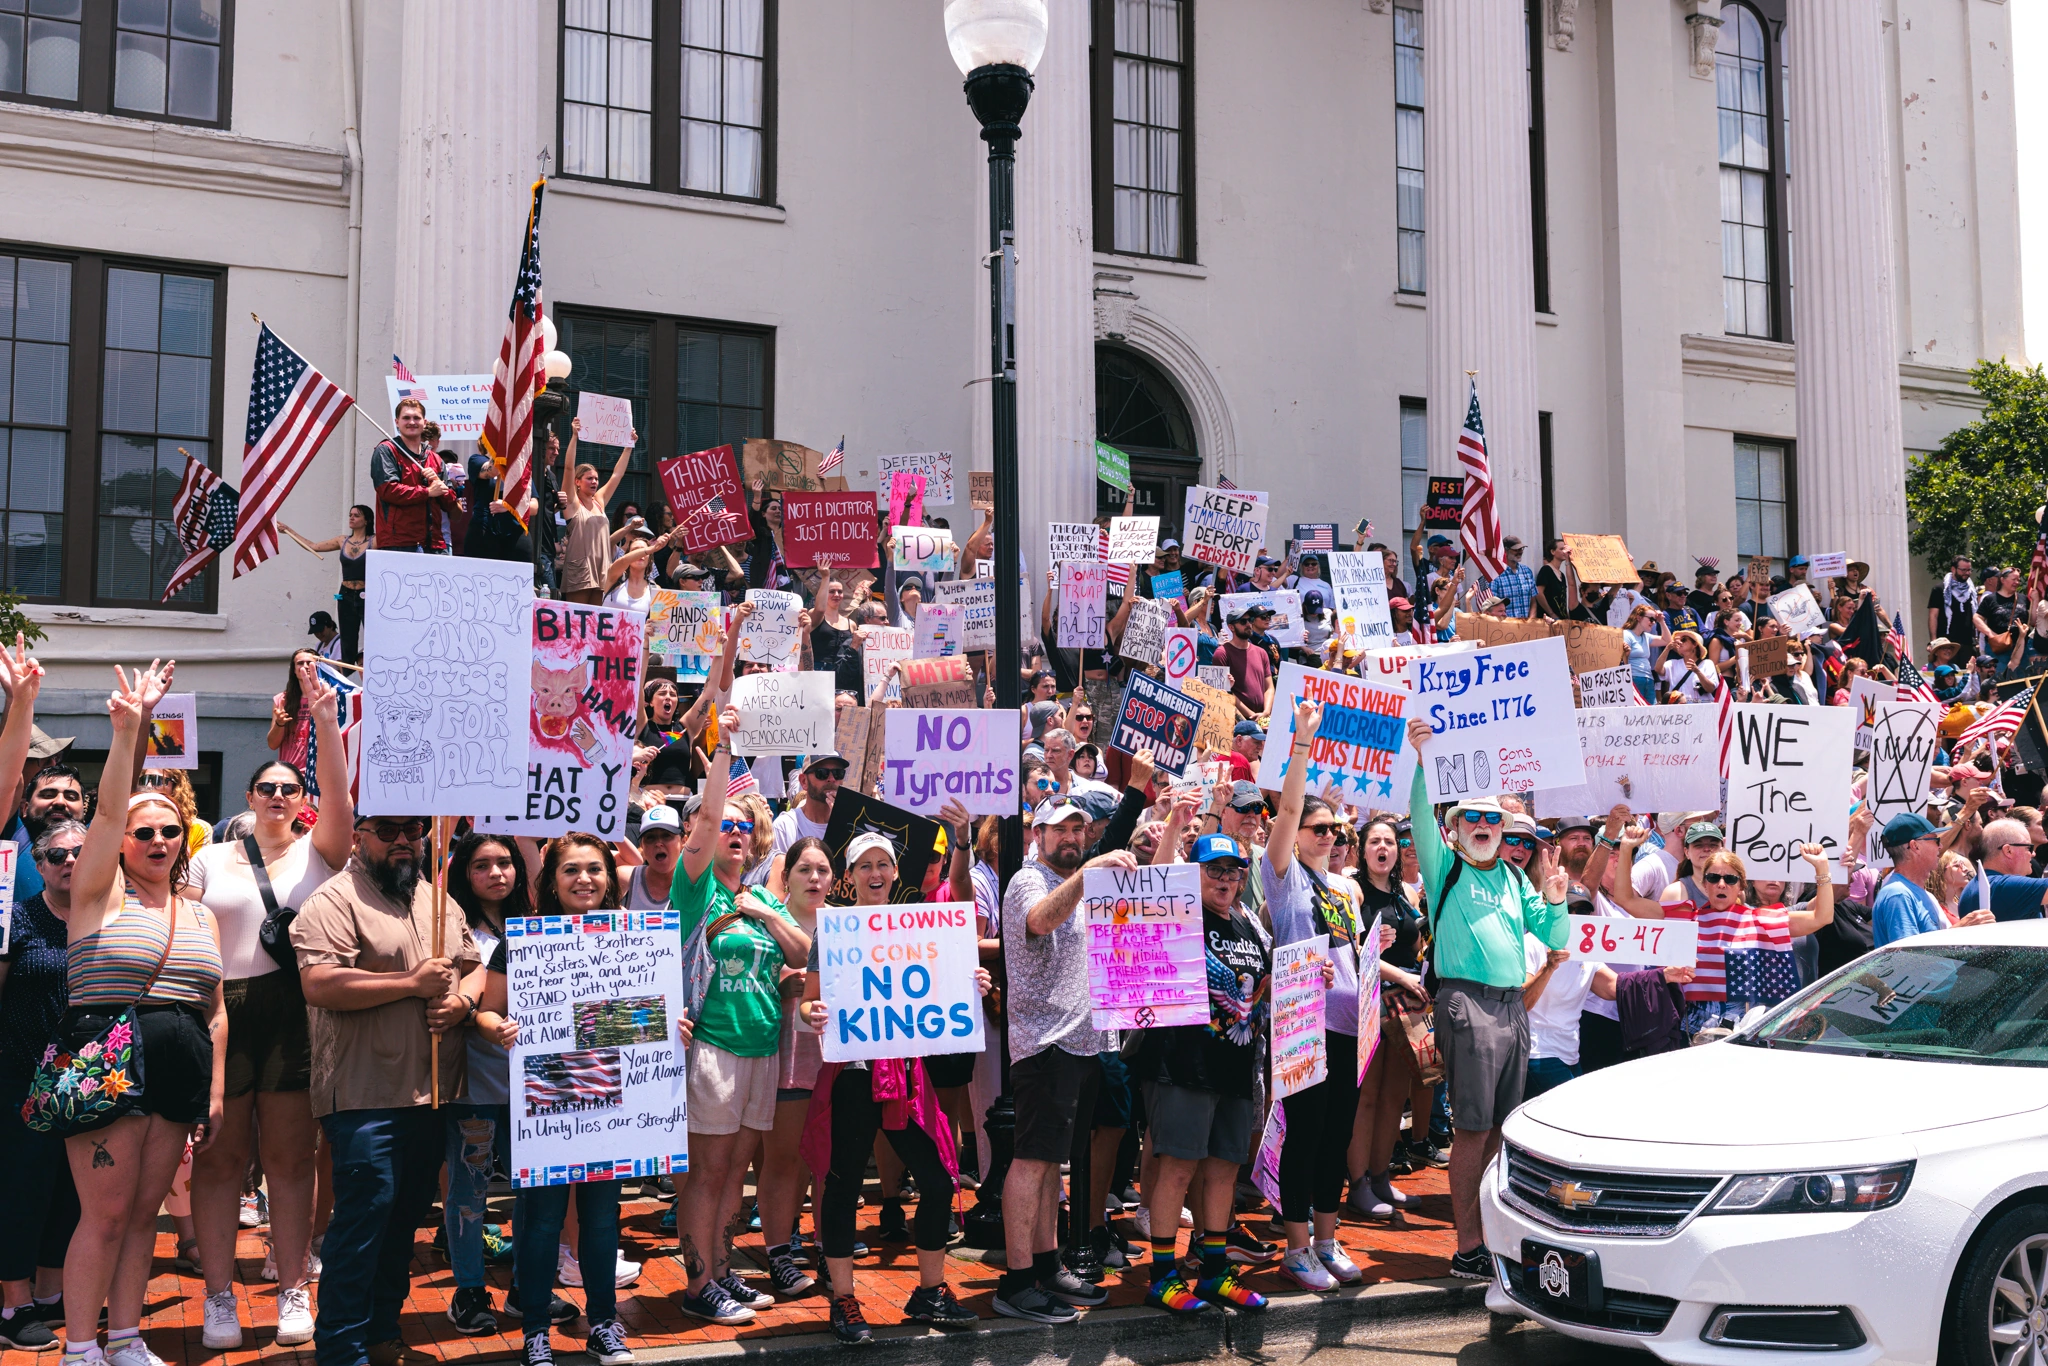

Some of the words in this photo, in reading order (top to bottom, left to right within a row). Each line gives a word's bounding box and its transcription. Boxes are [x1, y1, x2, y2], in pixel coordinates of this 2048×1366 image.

[456, 413, 472, 421] the
[595, 412, 630, 428] WORLD
[881, 455, 936, 470] DEFEND
[788, 503, 812, 520] NOT
[815, 502, 822, 518] A
[1203, 491, 1253, 518] KEEP
[684, 522, 748, 551] LEGAL
[795, 524, 826, 542] JUST
[830, 523, 839, 540] A
[1052, 524, 1071, 534] THE
[1072, 525, 1096, 536] ONLY
[1112, 531, 1157, 541] SILENCE
[1119, 521, 1156, 532] WILL
[902, 533, 950, 561] FDT
[1050, 534, 1094, 544] MINORITY
[1112, 540, 1125, 549] BE
[1195, 525, 1254, 554] DEPORT
[1336, 553, 1365, 568] KNOW
[1068, 565, 1108, 581] DONALD
[1331, 569, 1349, 584] YOUR
[1351, 567, 1386, 584] PARASITES
[753, 590, 794, 602] DONALD
[1360, 586, 1373, 594] TICK
[379, 570, 534, 636] LIBERTY
[754, 600, 791, 612] TRUMP
[1069, 601, 1080, 614] IS
[1086, 601, 1096, 614] A
[1364, 598, 1379, 607] TICK
[535, 607, 616, 642] BITE
[670, 606, 708, 624] HANDS
[751, 613, 765, 621] IS
[776, 613, 786, 622] A
[668, 623, 696, 643] OFF!
[1361, 621, 1391, 638] LUNATIC
[412, 621, 497, 664] AND
[865, 632, 880, 649] SO
[882, 631, 910, 650] FUCKED
[586, 655, 637, 682] THE
[1756, 654, 1769, 663] THE
[366, 655, 509, 701] JUSTICE
[907, 659, 965, 687] HATE
[1417, 661, 1471, 699] King
[1473, 653, 1529, 686] Free
[1581, 676, 1593, 692] NO
[1594, 667, 1632, 688] FASCISTS
[756, 676, 780, 694] PRO
[1185, 681, 1212, 697] ELECT
[741, 690, 805, 714] AMERICA!
[904, 689, 943, 709] NEVER
[945, 688, 975, 706] MADE
[1131, 676, 1199, 721] PRO-AMERICA
[1303, 675, 1340, 706] THIS
[1340, 684, 1359, 710] IS
[1361, 687, 1407, 719] WHAT
[1582, 694, 1595, 707] NO
[1597, 687, 1626, 705] NAZIS
[437, 699, 510, 739] FOR
[580, 686, 638, 740] HAND
[760, 713, 782, 728] PRO
[1125, 697, 1166, 732] STOP
[1429, 704, 1488, 735] Since
[1491, 693, 1537, 722] 1776
[1577, 715, 1606, 729] HIS
[1623, 713, 1693, 728] WANNABE
[740, 721, 818, 750] DEMOCRACY!
[915, 714, 972, 753] NO
[1321, 708, 1401, 747] MOCRACY
[1120, 723, 1186, 770] TRUMP
[1604, 732, 1680, 748] DESERVES
[1692, 733, 1704, 744] A
[1736, 710, 1810, 773] WE
[437, 737, 523, 789] ALL
[1289, 732, 1350, 768] LOKS
[1352, 743, 1395, 777] LIKE
[1584, 754, 1627, 768] OYAL
[1642, 753, 1699, 767] FLUSH!
[379, 765, 424, 784] TRASH
[527, 763, 583, 794] HAT
[1435, 749, 1491, 796] NO
[1498, 747, 1533, 762] Cons
[886, 759, 1015, 807] Tyrants
[1501, 777, 1535, 792] Kings
[1746, 777, 1813, 815] The
[1731, 813, 1840, 874] People
[1112, 866, 1170, 894] WHY
[823, 914, 861, 934] NO
[867, 909, 967, 931] CLOWNS
[1088, 924, 1148, 938] BECAUSE
[1153, 923, 1182, 937] IT'S
[594, 933, 654, 950] Brothers
[514, 965, 538, 979] and
[588, 953, 612, 966] We
[615, 949, 639, 963] See
[646, 947, 674, 967] you,
[826, 946, 863, 967] NO
[870, 941, 939, 964] CONS
[1090, 952, 1126, 965] THAN
[1225, 954, 1246, 966] Takes
[512, 980, 535, 991] we
[538, 975, 565, 988] hear
[571, 971, 593, 987] you,
[598, 966, 621, 978] and
[628, 964, 648, 974] we
[1106, 965, 1151, 978] FRIENDS
[1154, 964, 1178, 977] AND
[719, 978, 778, 996] RAMON
[862, 963, 931, 1001] NO
[516, 990, 567, 1009] STAND
[571, 979, 605, 998] with
[1098, 993, 1120, 1005] IN
[1128, 990, 1146, 1003] MY
[508, 1011, 538, 1029] You
[537, 1009, 563, 1022] are
[838, 1002, 974, 1044] KINGS
[512, 1029, 538, 1047] Not
[622, 1048, 650, 1071] You
[651, 1049, 673, 1063] are
[518, 1119, 532, 1141] In
[535, 1118, 573, 1140] Unity
[575, 1116, 601, 1135] lies
[607, 1117, 633, 1130] our
[637, 1101, 688, 1133] Strength!
